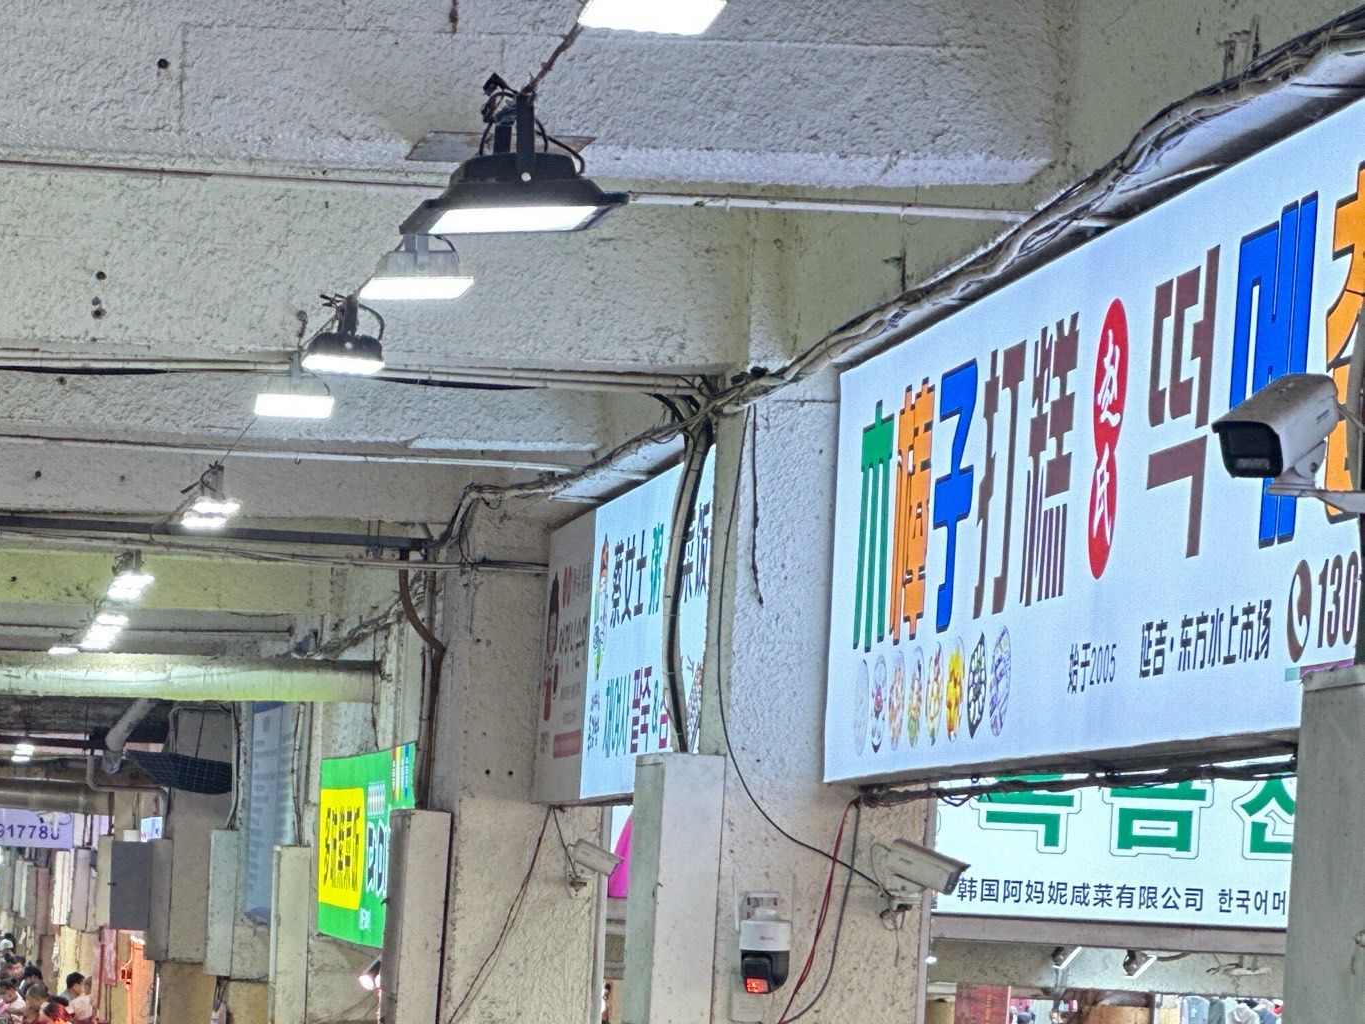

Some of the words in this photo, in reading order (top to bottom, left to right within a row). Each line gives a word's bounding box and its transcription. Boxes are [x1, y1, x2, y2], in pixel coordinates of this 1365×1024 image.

[1067, 642, 1117, 693] 始于2005
[957, 876, 1205, 913] 韩国阿妈妮咸菜有限公司
